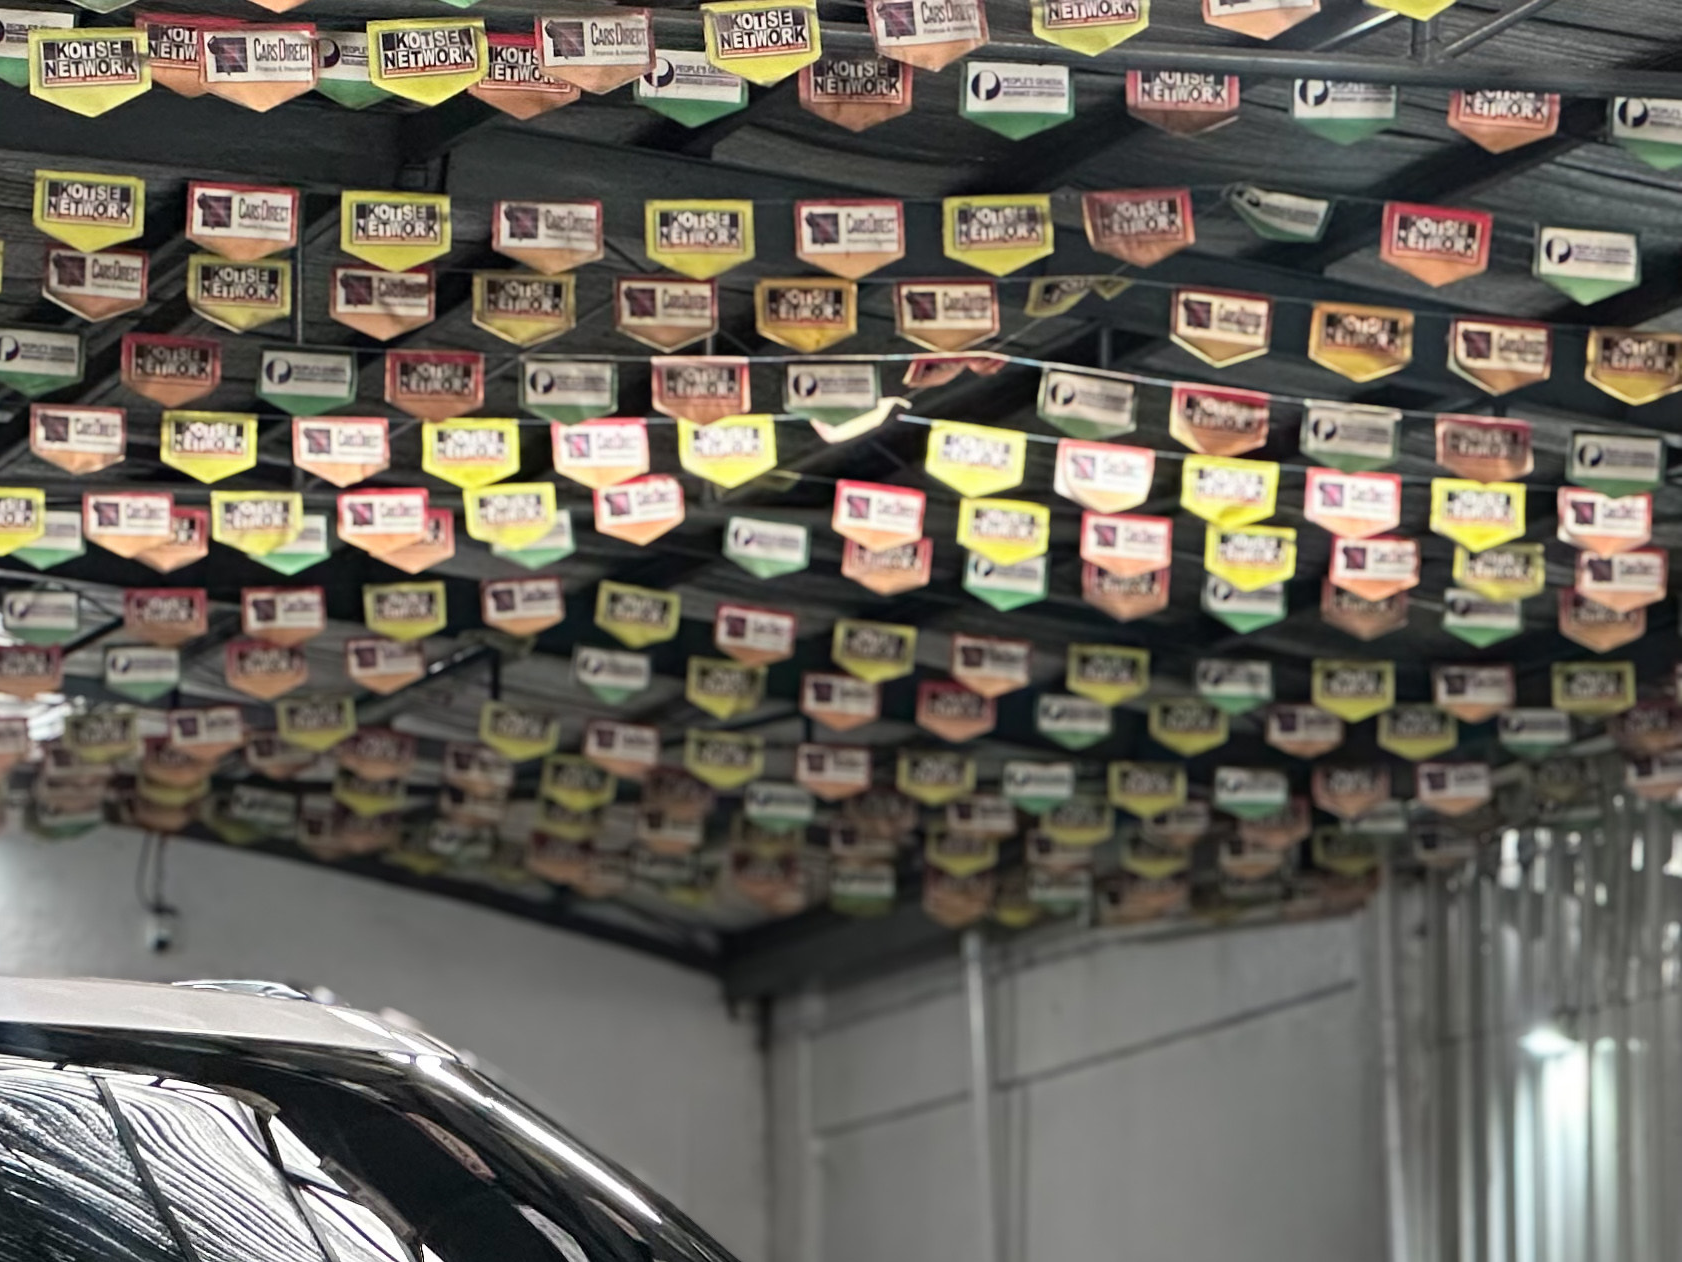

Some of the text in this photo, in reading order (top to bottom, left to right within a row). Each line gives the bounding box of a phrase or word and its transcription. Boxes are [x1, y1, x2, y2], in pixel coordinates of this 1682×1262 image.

[1048, 0, 1136, 19] NETWORK
[729, 9, 792, 30] KOTSE
[161, 28, 197, 45] KOT
[396, 28, 460, 48] KOTSE
[720, 27, 807, 49] NETWORK
[149, 42, 197, 59] NETW
[385, 45, 475, 68] NETWORK
[494, 47, 538, 63] KOTS
[814, 76, 899, 95] NETWORK
